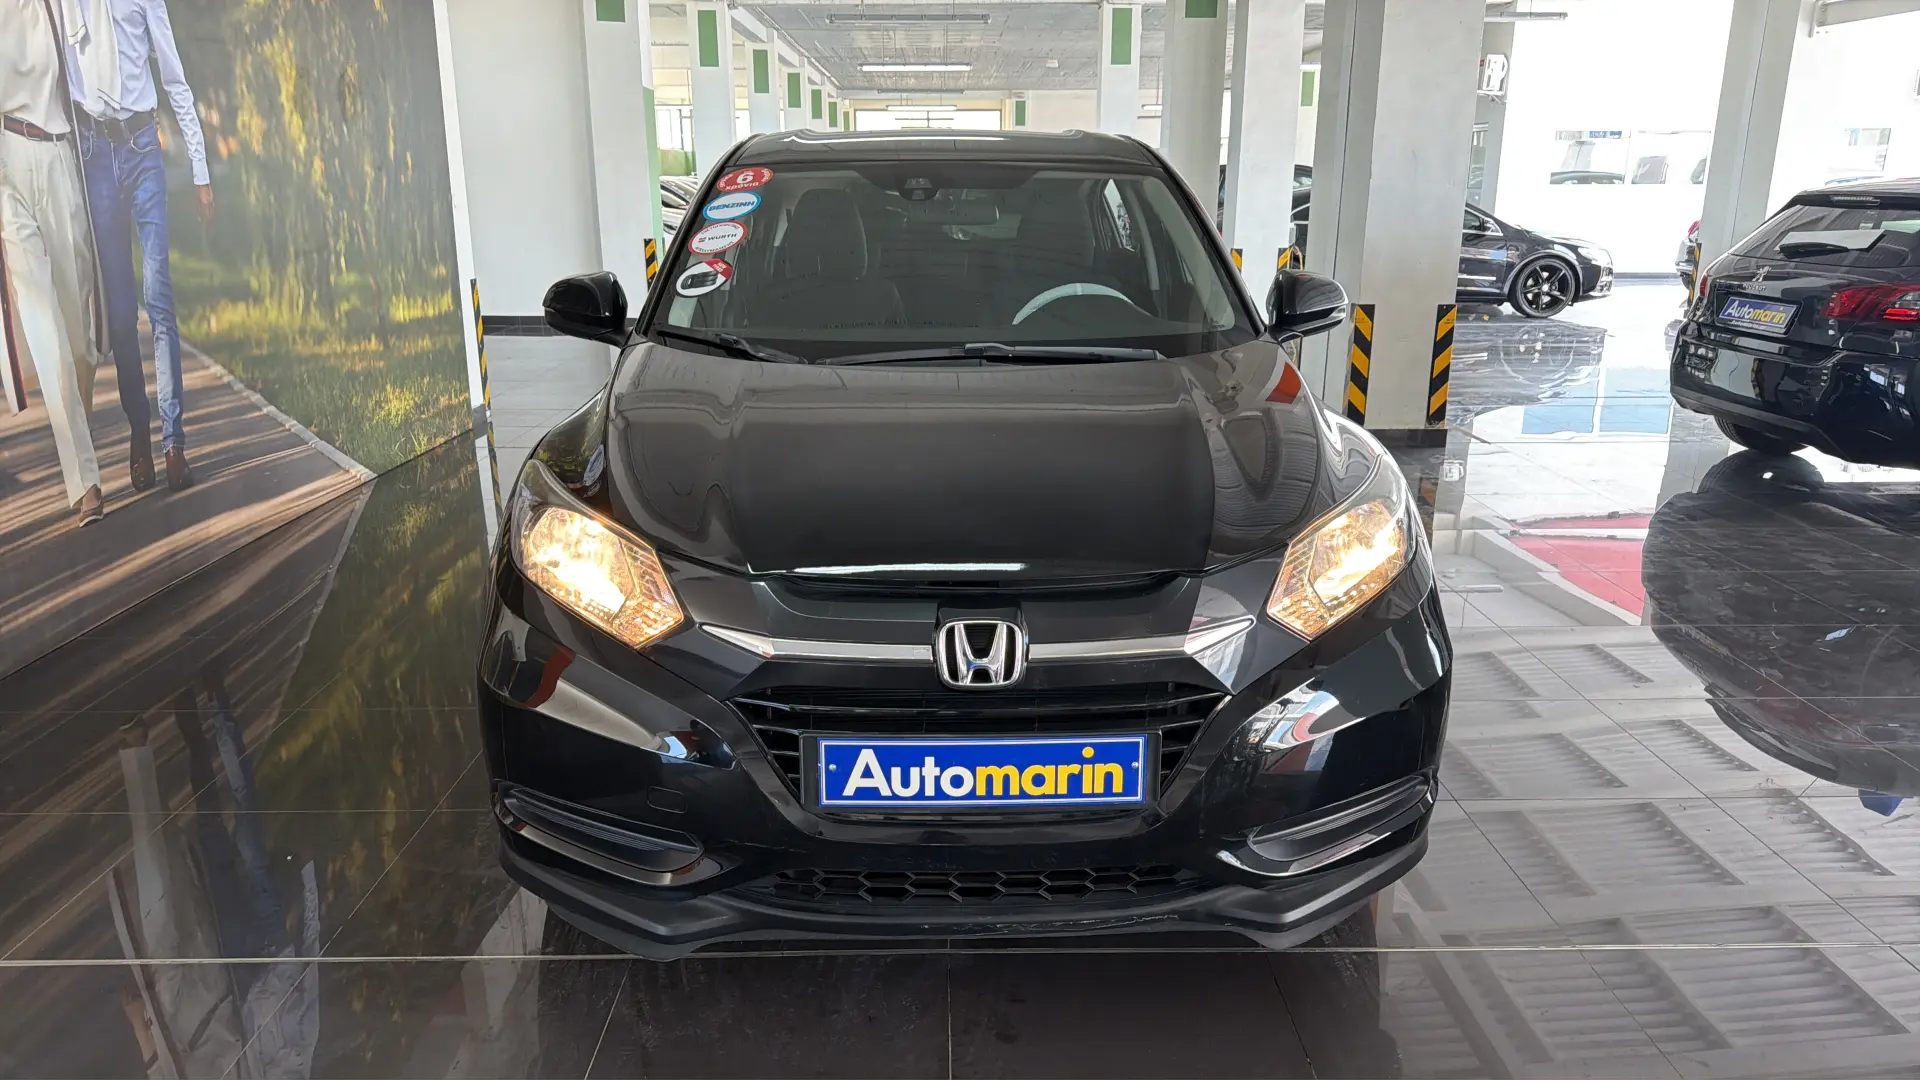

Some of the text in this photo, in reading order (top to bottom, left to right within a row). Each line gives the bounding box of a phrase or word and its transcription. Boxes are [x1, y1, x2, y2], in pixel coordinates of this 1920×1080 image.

[736, 172, 754, 184] 6
[1724, 300, 1786, 323] Automarin
[842, 746, 1124, 797] Automarin
